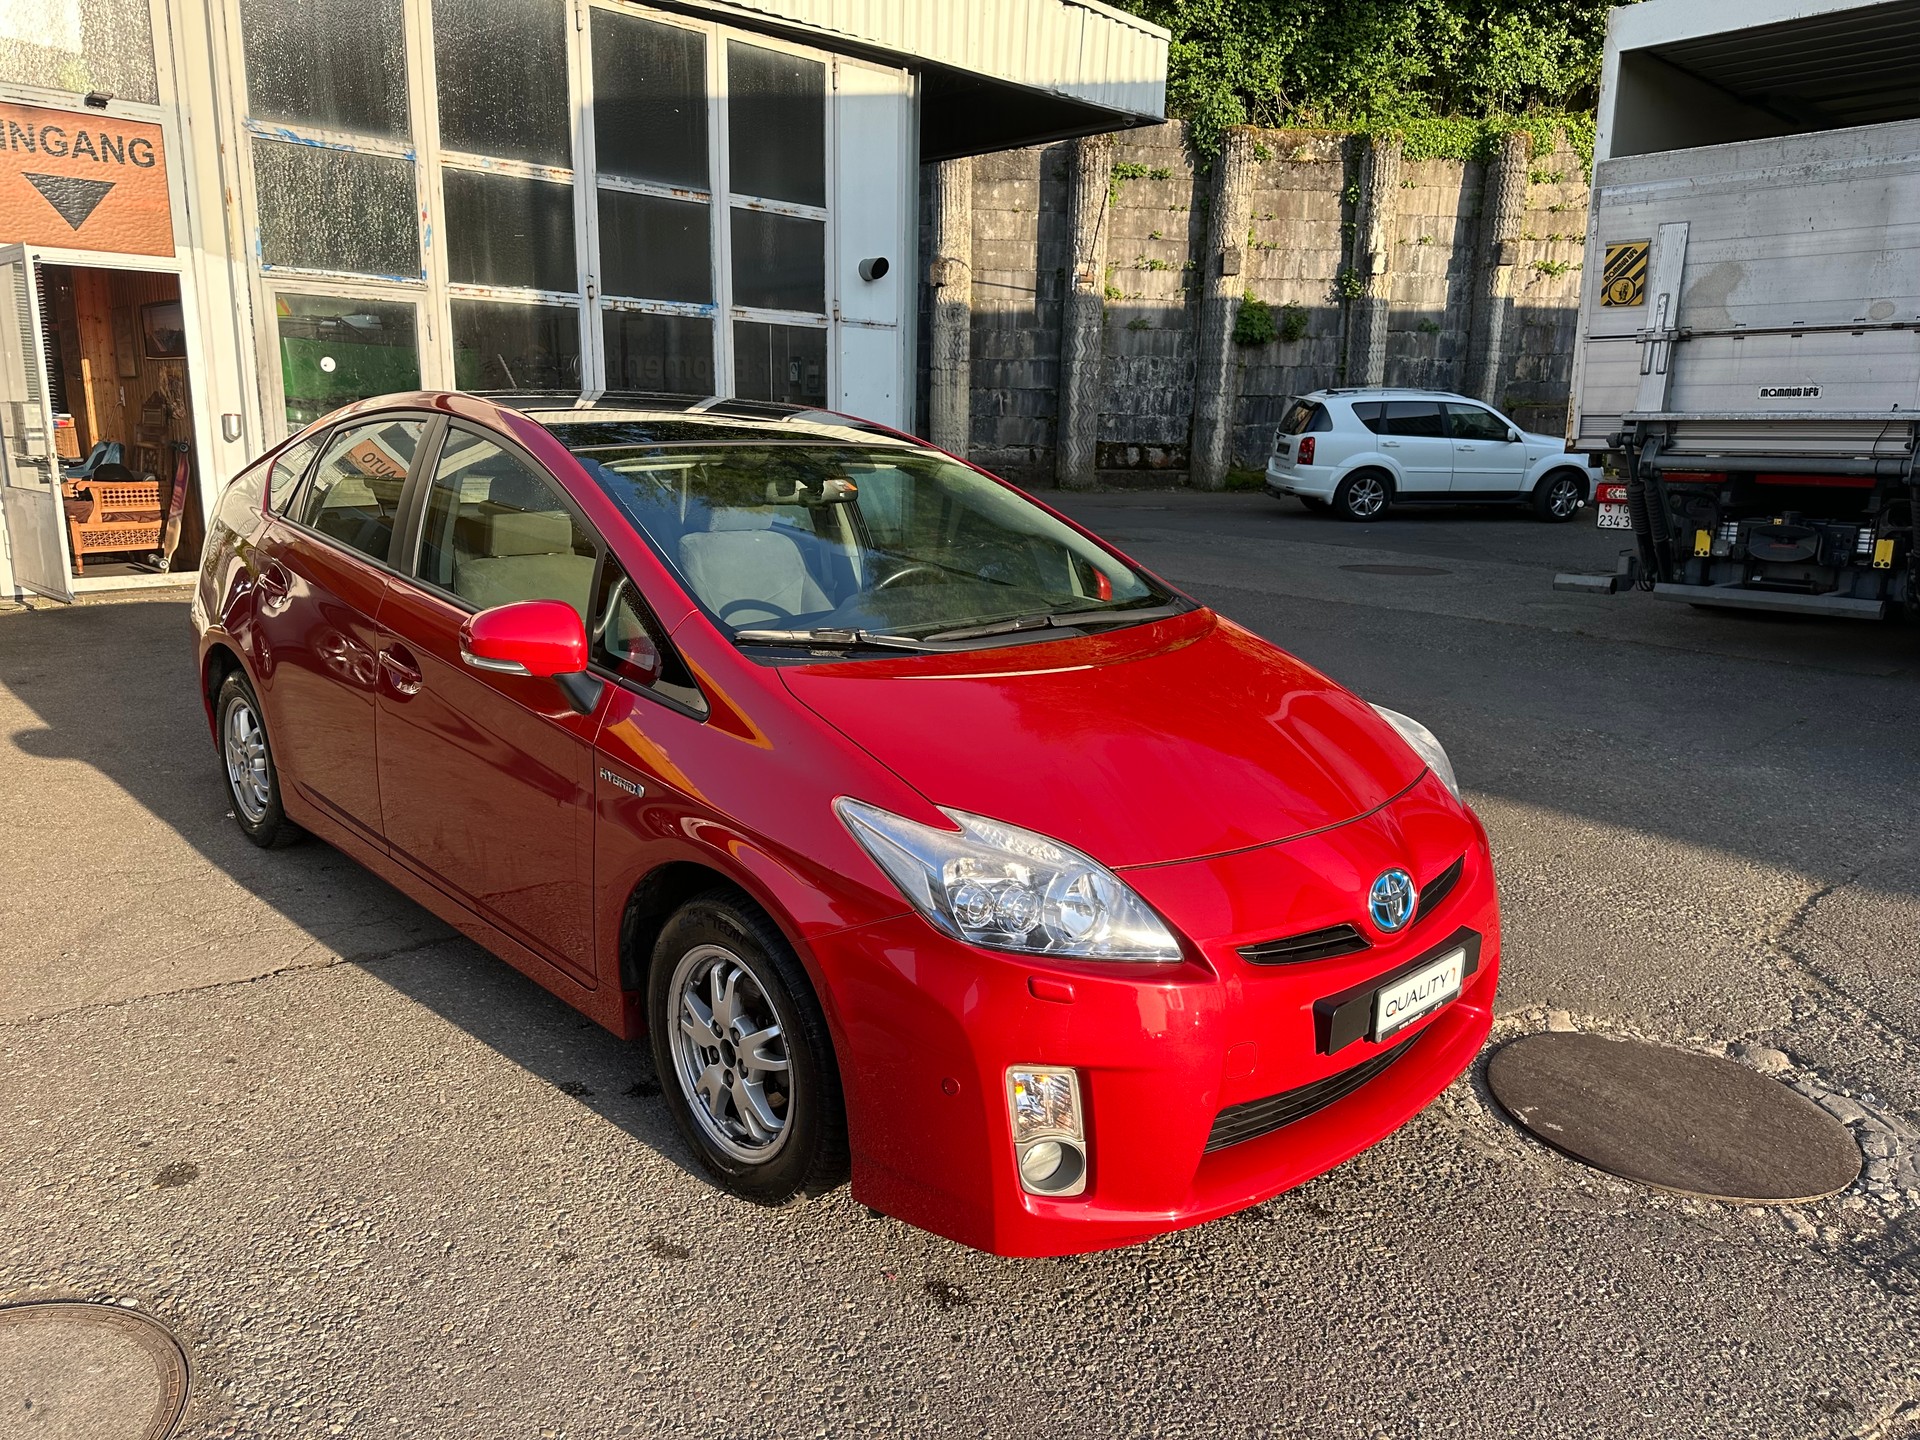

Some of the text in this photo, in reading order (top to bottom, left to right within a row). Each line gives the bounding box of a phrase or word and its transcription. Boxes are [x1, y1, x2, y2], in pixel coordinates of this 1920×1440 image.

[0, 119, 156, 168] INGANG
[1760, 386, 1819, 397] mammut lift
[1618, 504, 1629, 514] TG
[599, 767, 637, 795] HYBRID
